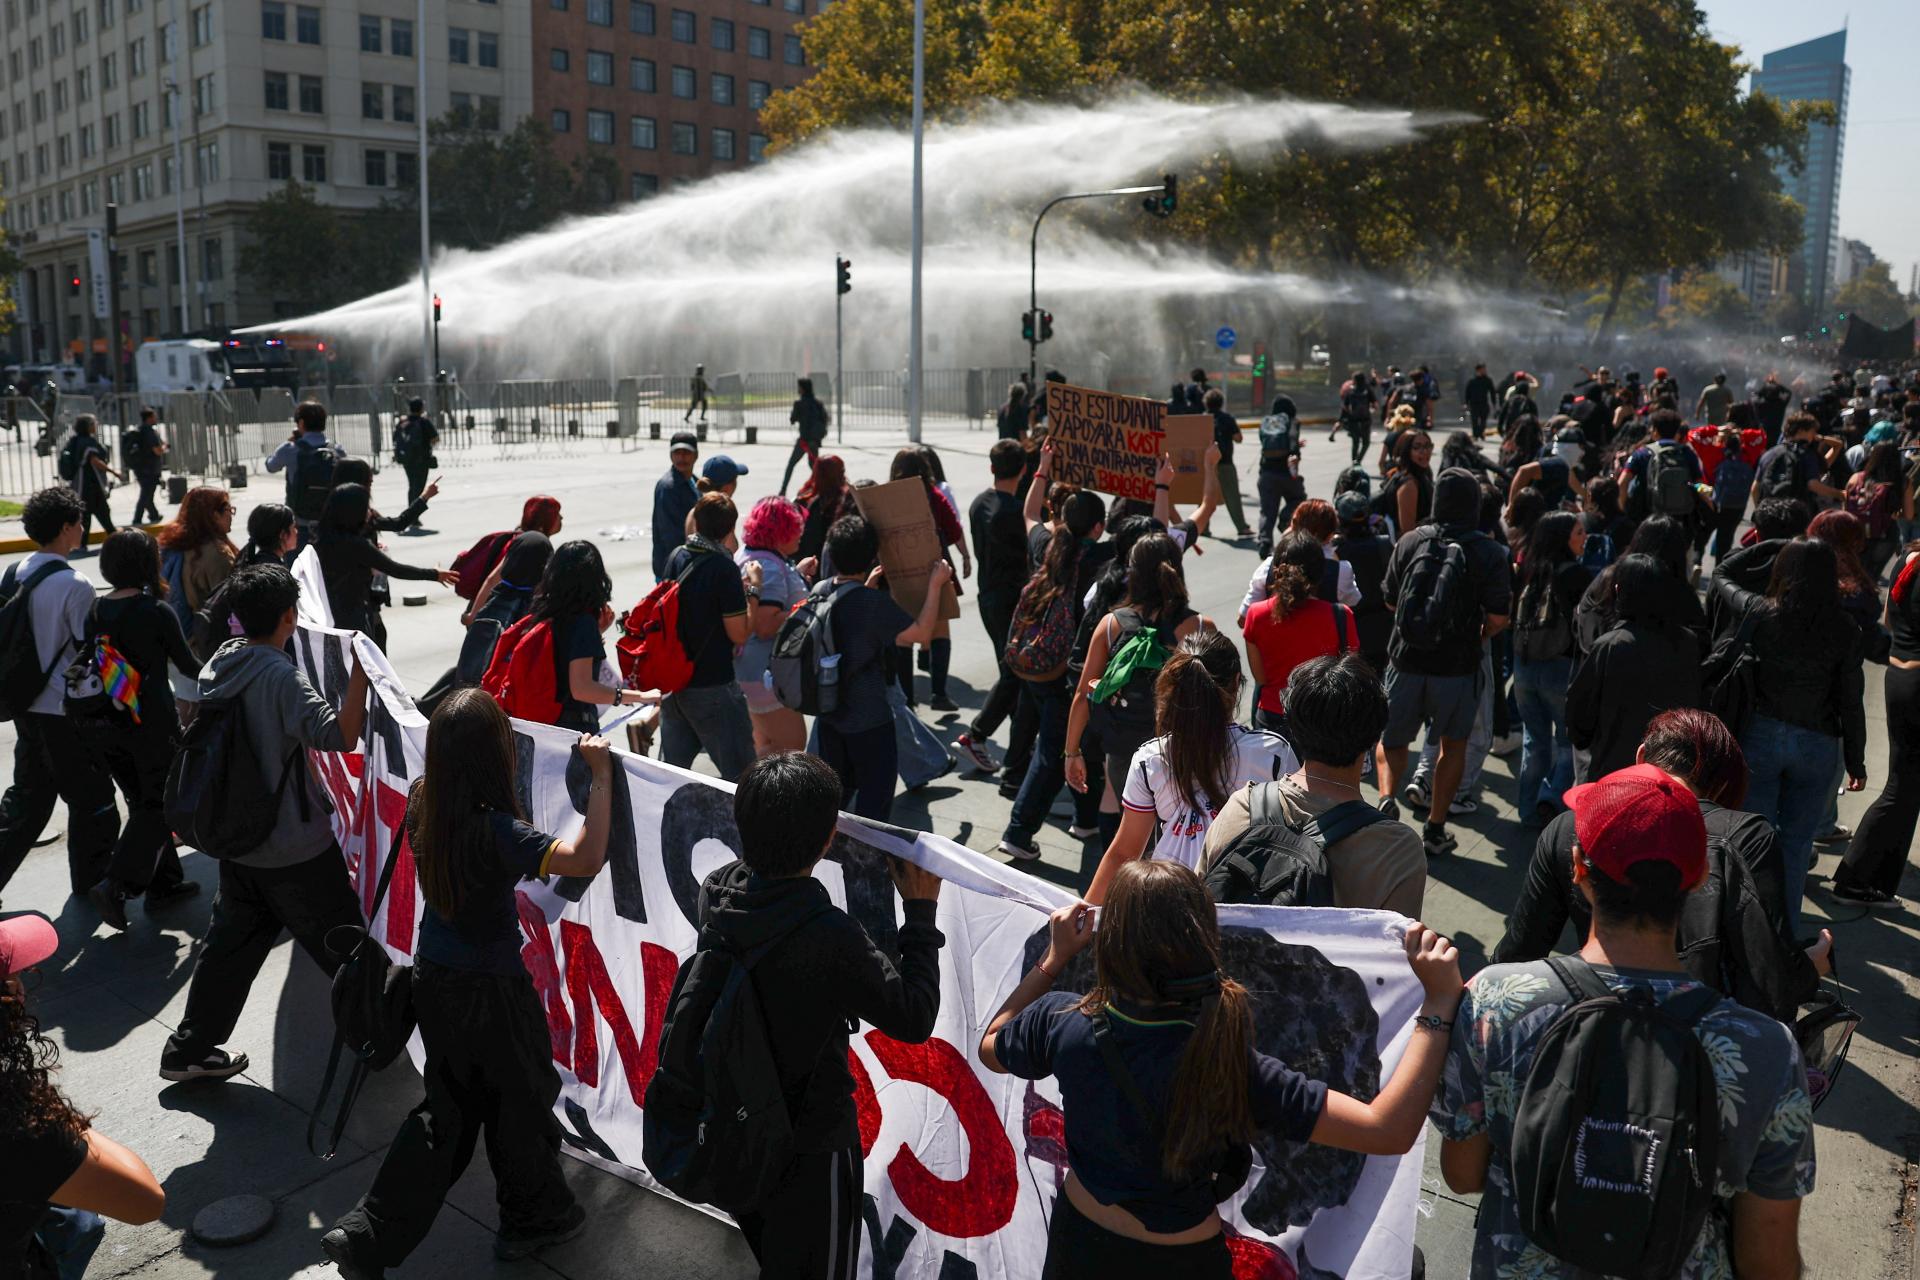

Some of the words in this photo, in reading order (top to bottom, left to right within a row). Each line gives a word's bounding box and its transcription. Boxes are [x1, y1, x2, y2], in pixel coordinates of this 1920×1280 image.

[1050, 387, 1081, 415] SER
[1087, 394, 1168, 432] ESTUDIANTE
[1127, 430, 1166, 456] KAST
[1052, 455, 1098, 489] HASTA
[1097, 467, 1157, 501] BIOLÓGIC
